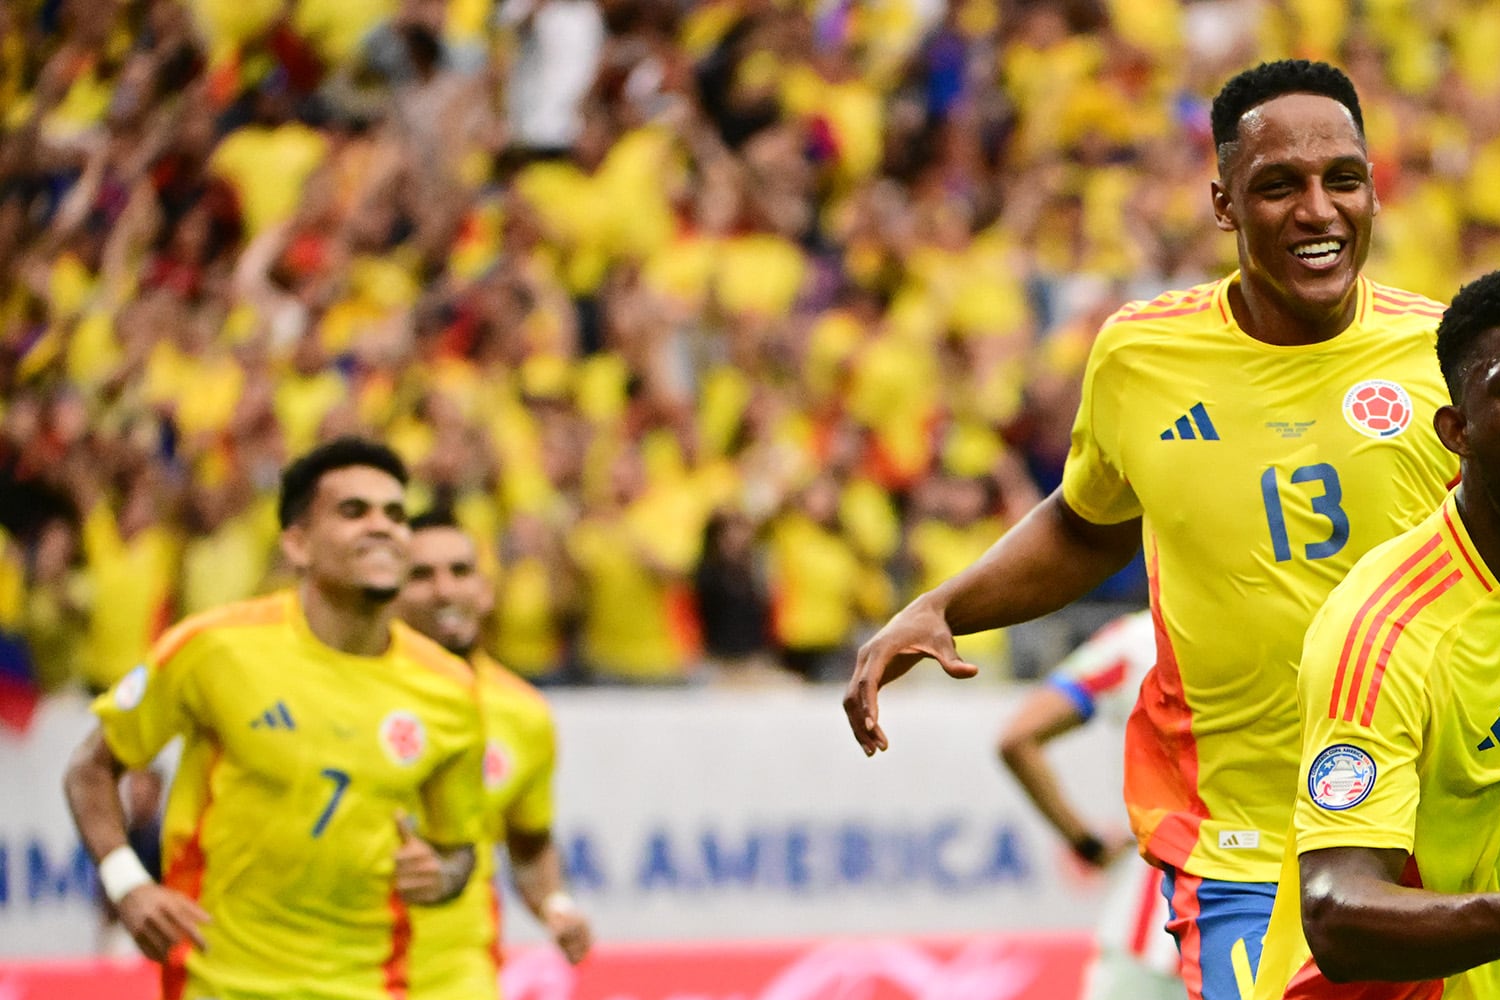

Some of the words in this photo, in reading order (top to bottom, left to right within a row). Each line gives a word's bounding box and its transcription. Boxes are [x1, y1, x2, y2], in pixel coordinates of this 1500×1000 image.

[1261, 462, 1350, 562] 13
[312, 769, 351, 838] 7
[638, 818, 1033, 892] AMERICA
